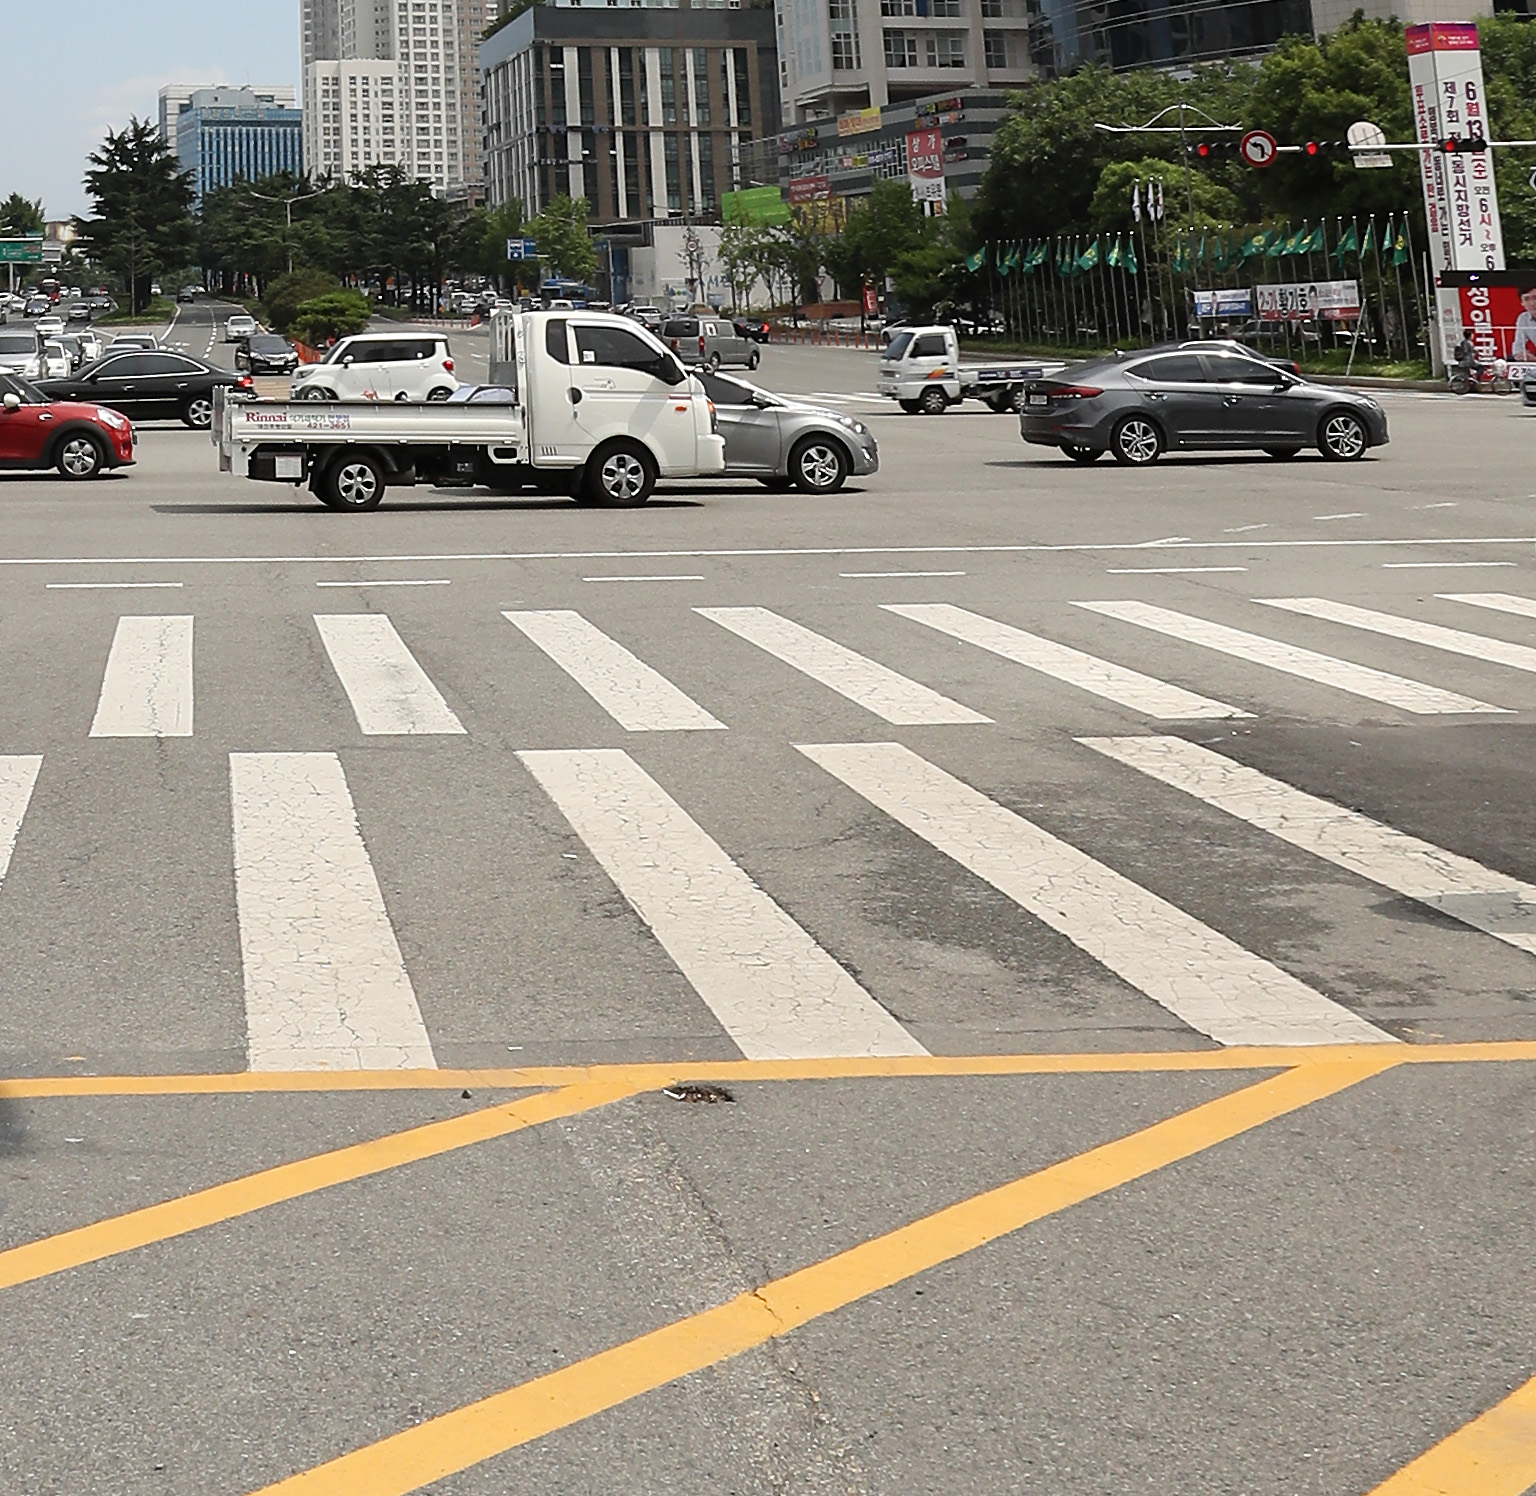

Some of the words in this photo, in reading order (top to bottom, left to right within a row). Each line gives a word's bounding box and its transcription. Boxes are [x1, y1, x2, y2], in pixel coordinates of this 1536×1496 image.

[1443, 82, 1460, 123] 제7회
[1465, 81, 1480, 117] 6월
[1466, 120, 1488, 180] 13(수)
[246, 412, 287, 422] Rinnai
